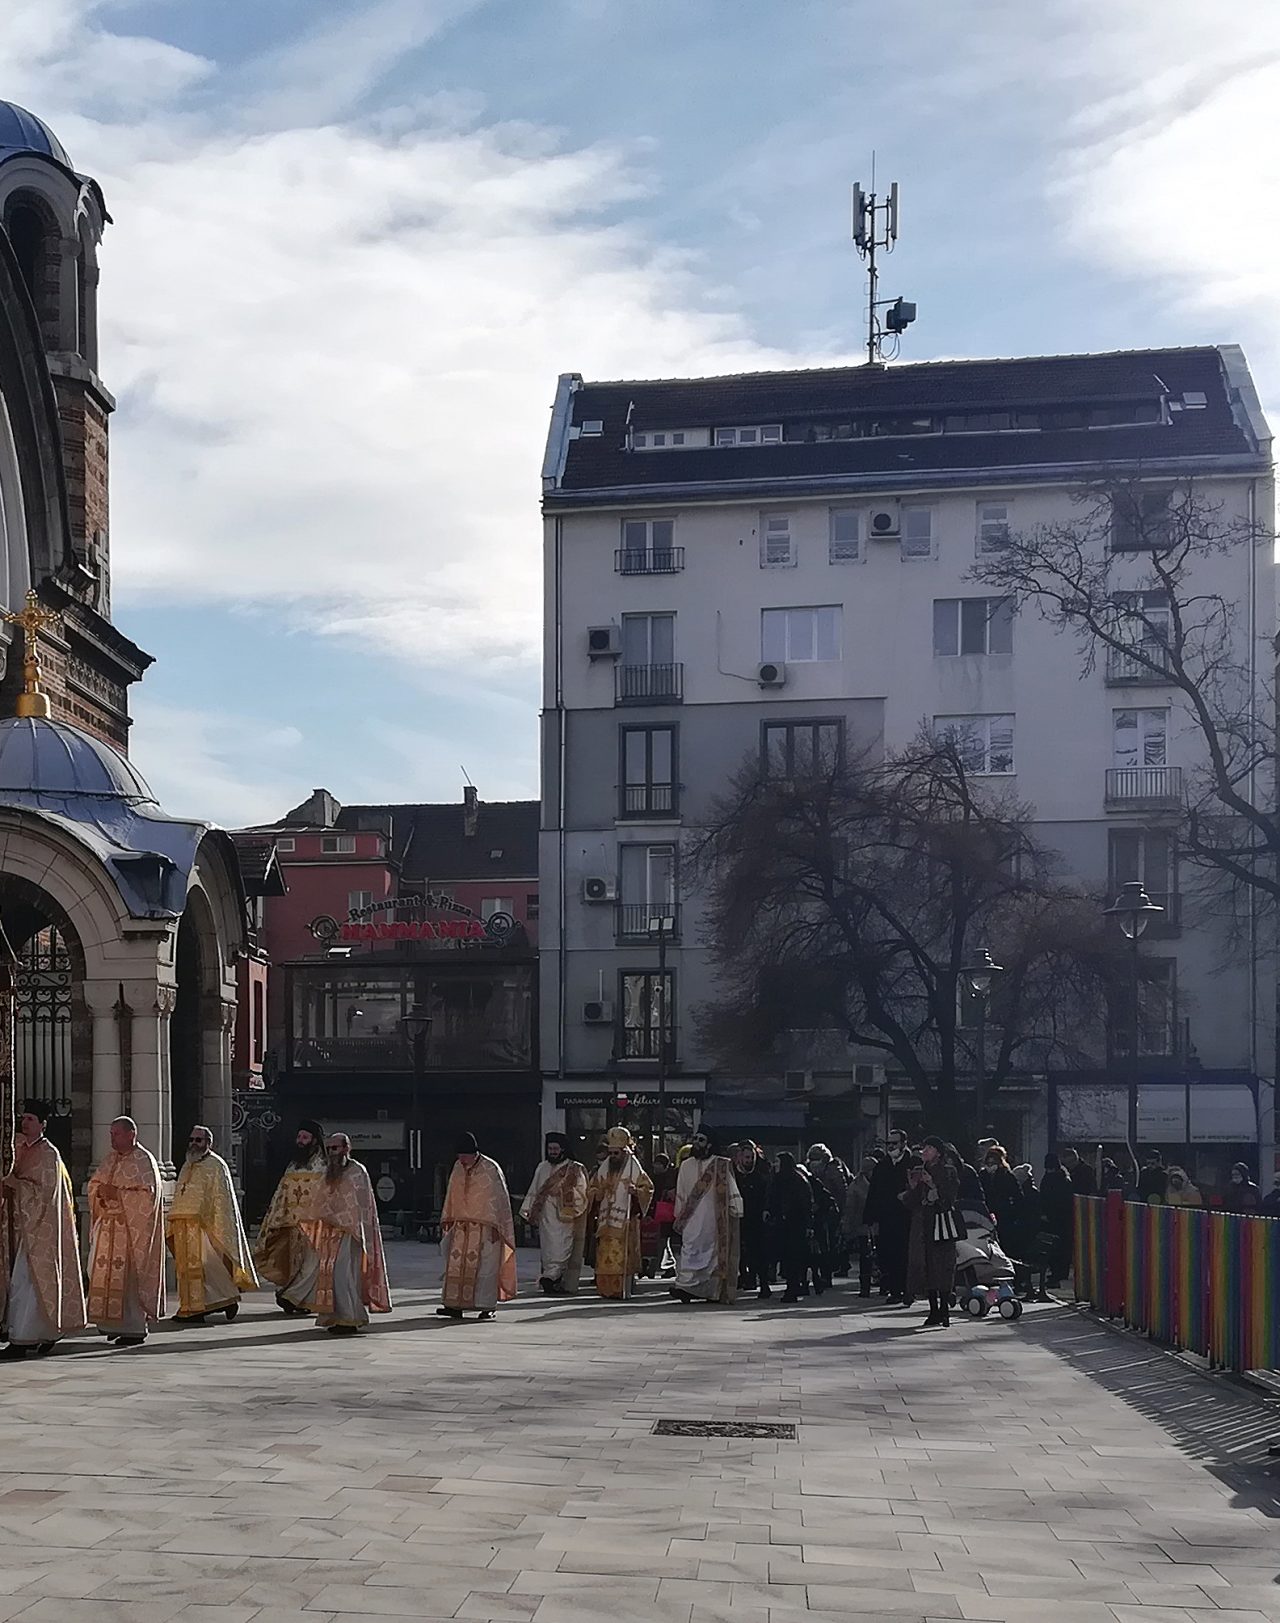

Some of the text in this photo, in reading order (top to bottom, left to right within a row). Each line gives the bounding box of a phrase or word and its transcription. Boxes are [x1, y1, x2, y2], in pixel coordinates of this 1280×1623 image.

[349, 896, 422, 921] Restaurant
[438, 895, 472, 917] Pizza
[340, 919, 488, 940] MAMMA MIA
